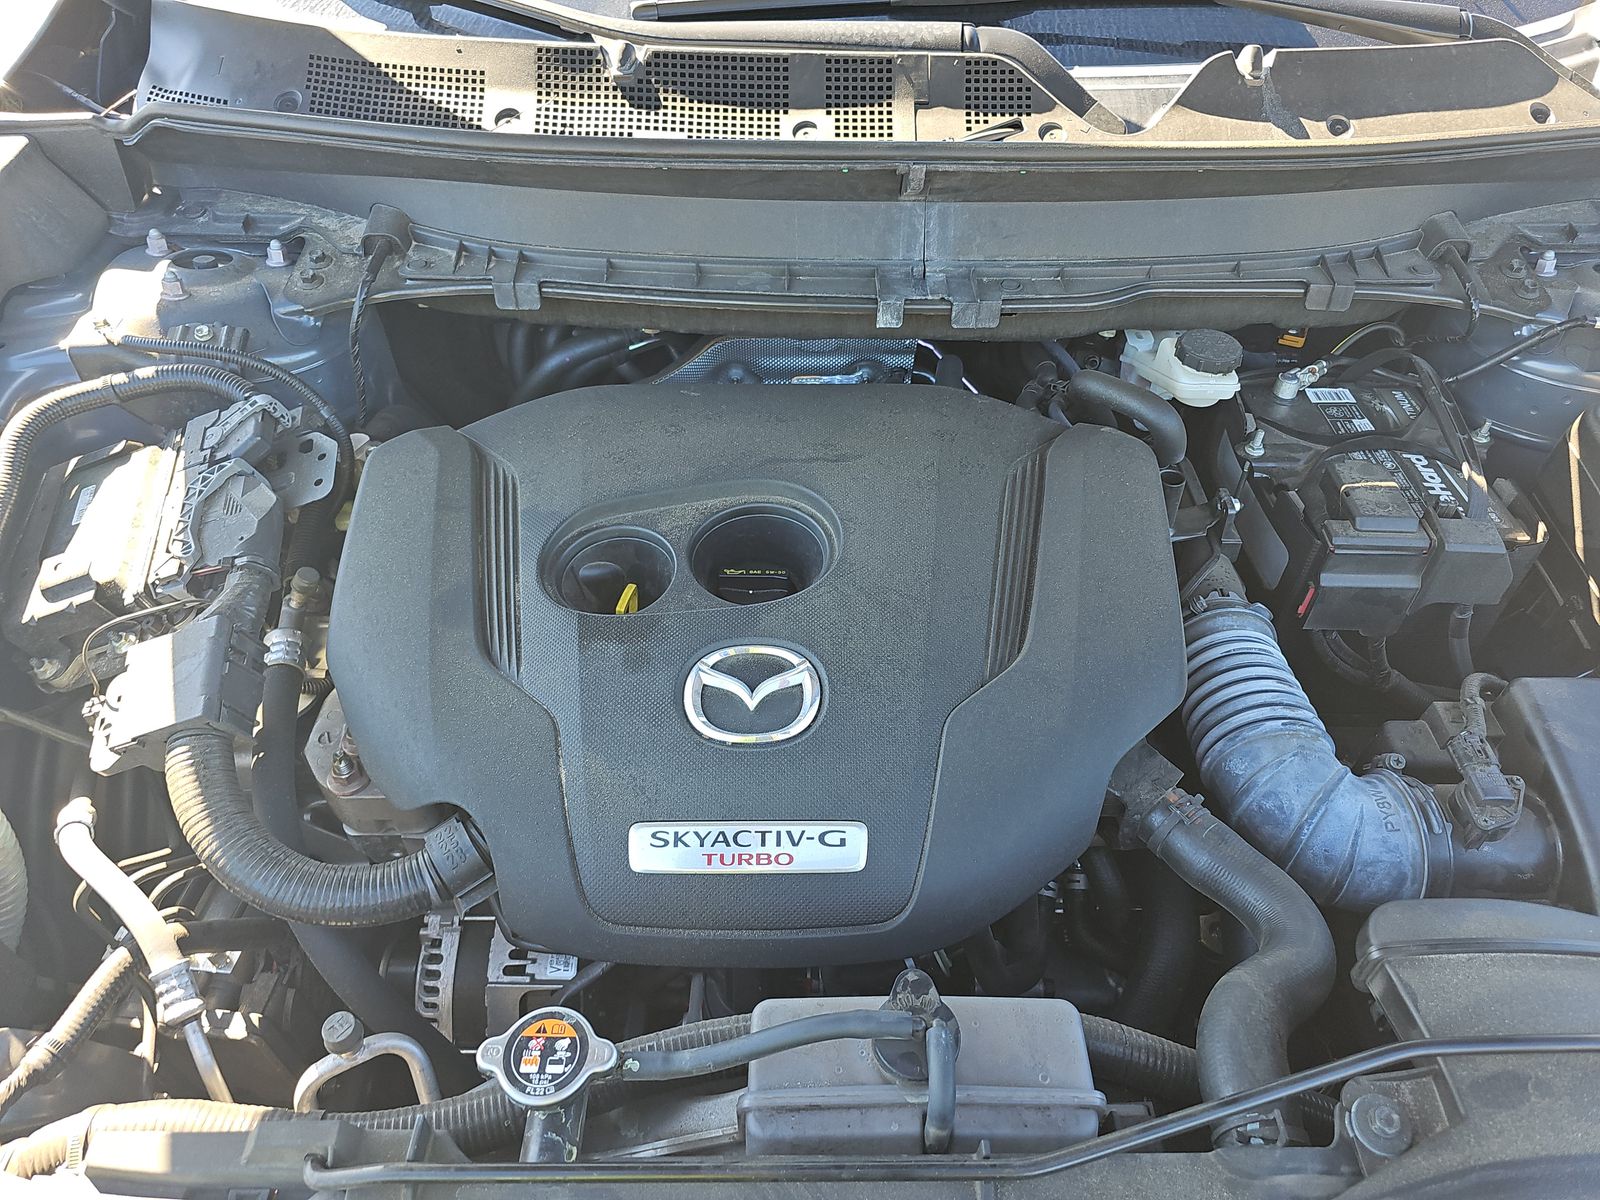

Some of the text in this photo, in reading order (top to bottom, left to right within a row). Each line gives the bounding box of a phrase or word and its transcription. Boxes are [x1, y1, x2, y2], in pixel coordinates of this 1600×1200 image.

[1402, 453, 1465, 517] eHard
[1367, 789, 1400, 832] PY8W
[649, 829, 847, 848] SKYACTIV-G
[701, 853, 795, 866] TURBO
[525, 1086, 544, 1095] FL22
